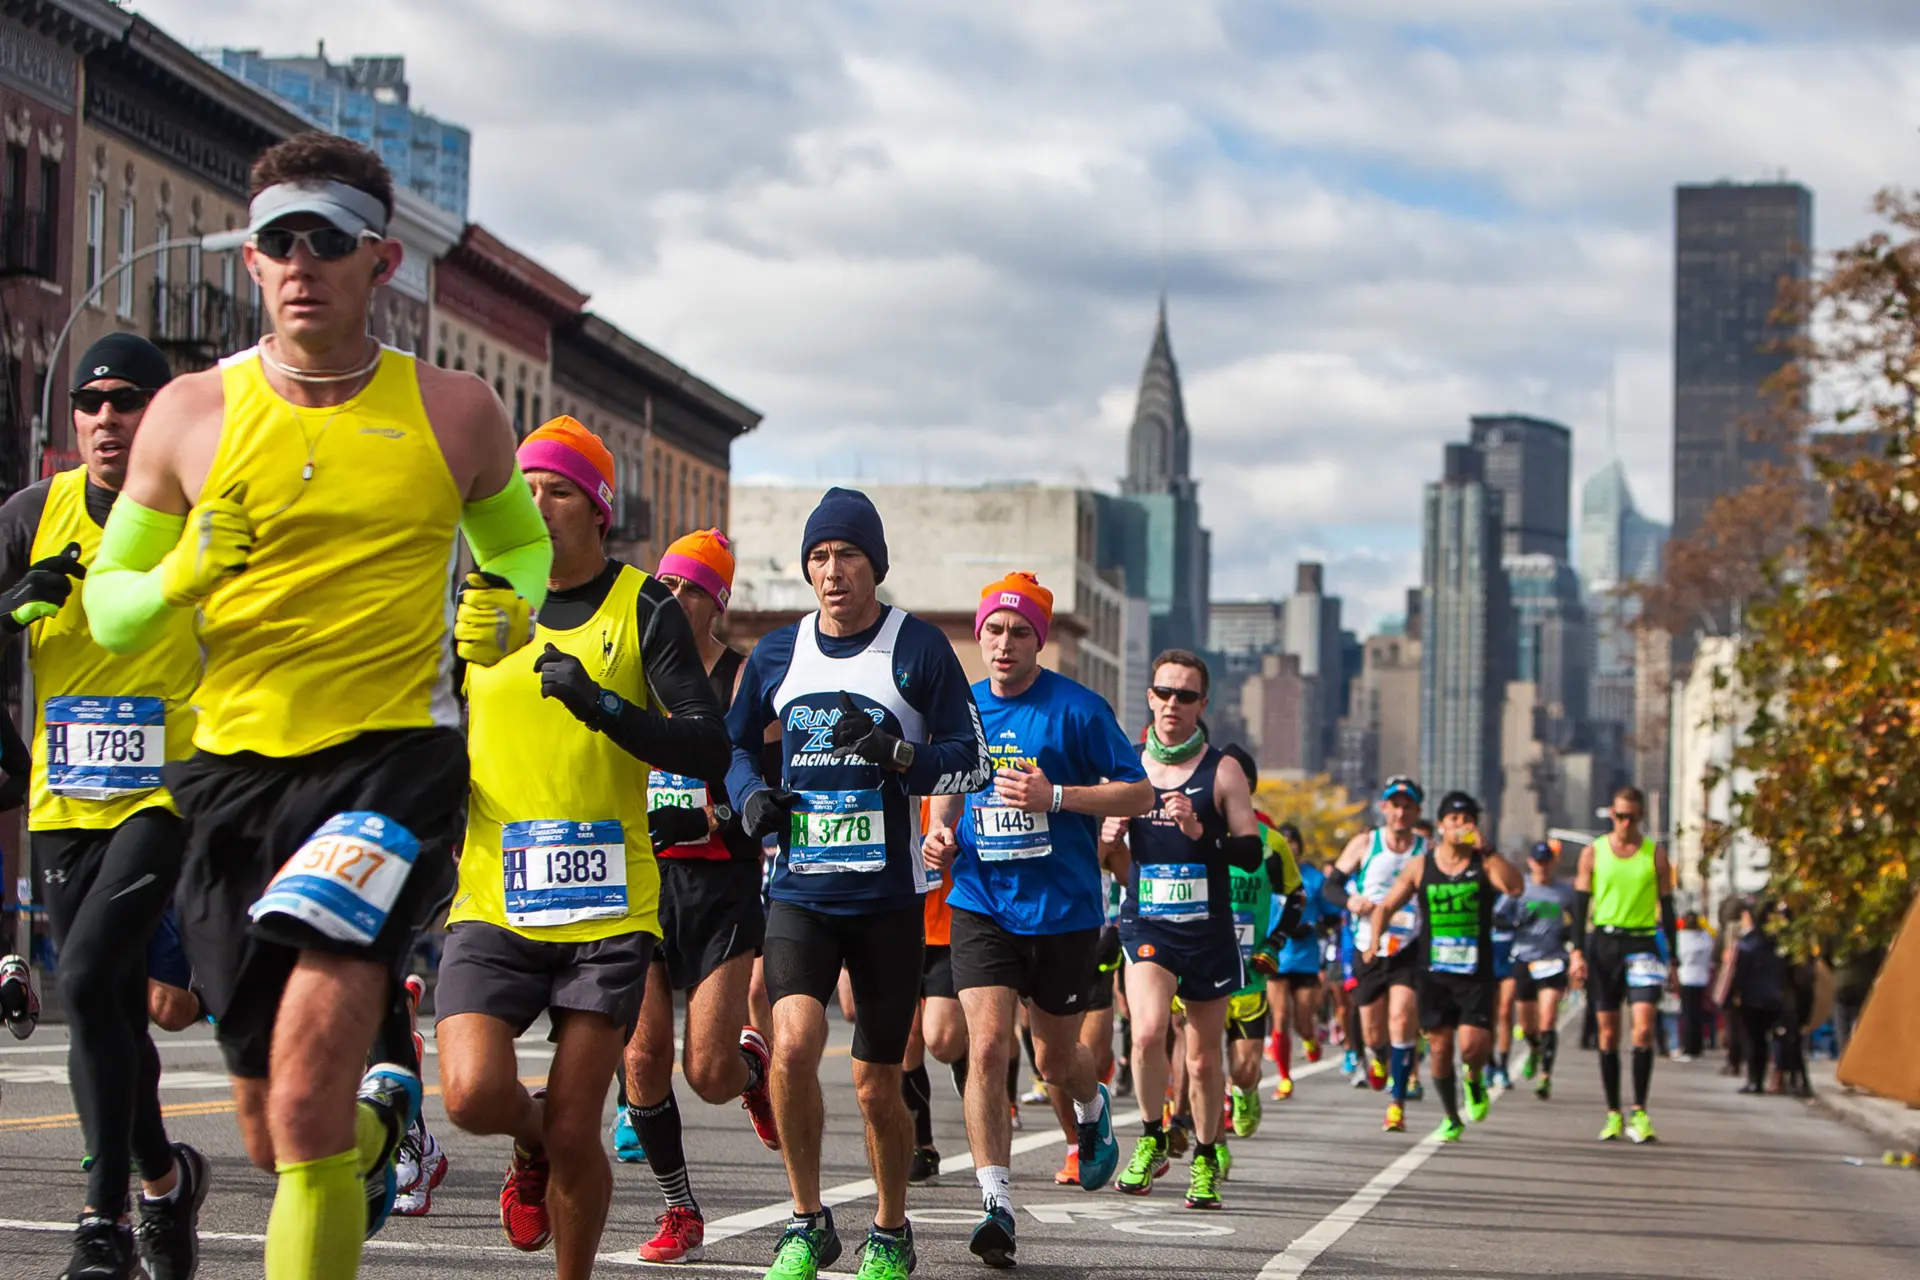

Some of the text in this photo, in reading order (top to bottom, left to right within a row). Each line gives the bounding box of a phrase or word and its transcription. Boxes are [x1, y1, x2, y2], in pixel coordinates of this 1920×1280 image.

[54, 746, 66, 763] A
[87, 730, 145, 762] 1783
[843, 753, 879, 767] TEA
[990, 757, 1038, 770] OSTON
[818, 815, 871, 844] 3778
[995, 811, 1035, 832] 1445
[798, 832, 806, 845] A
[304, 841, 386, 889] 5127
[546, 849, 607, 884] 1383
[513, 872, 525, 889] A
[1168, 883, 1192, 901] 701
